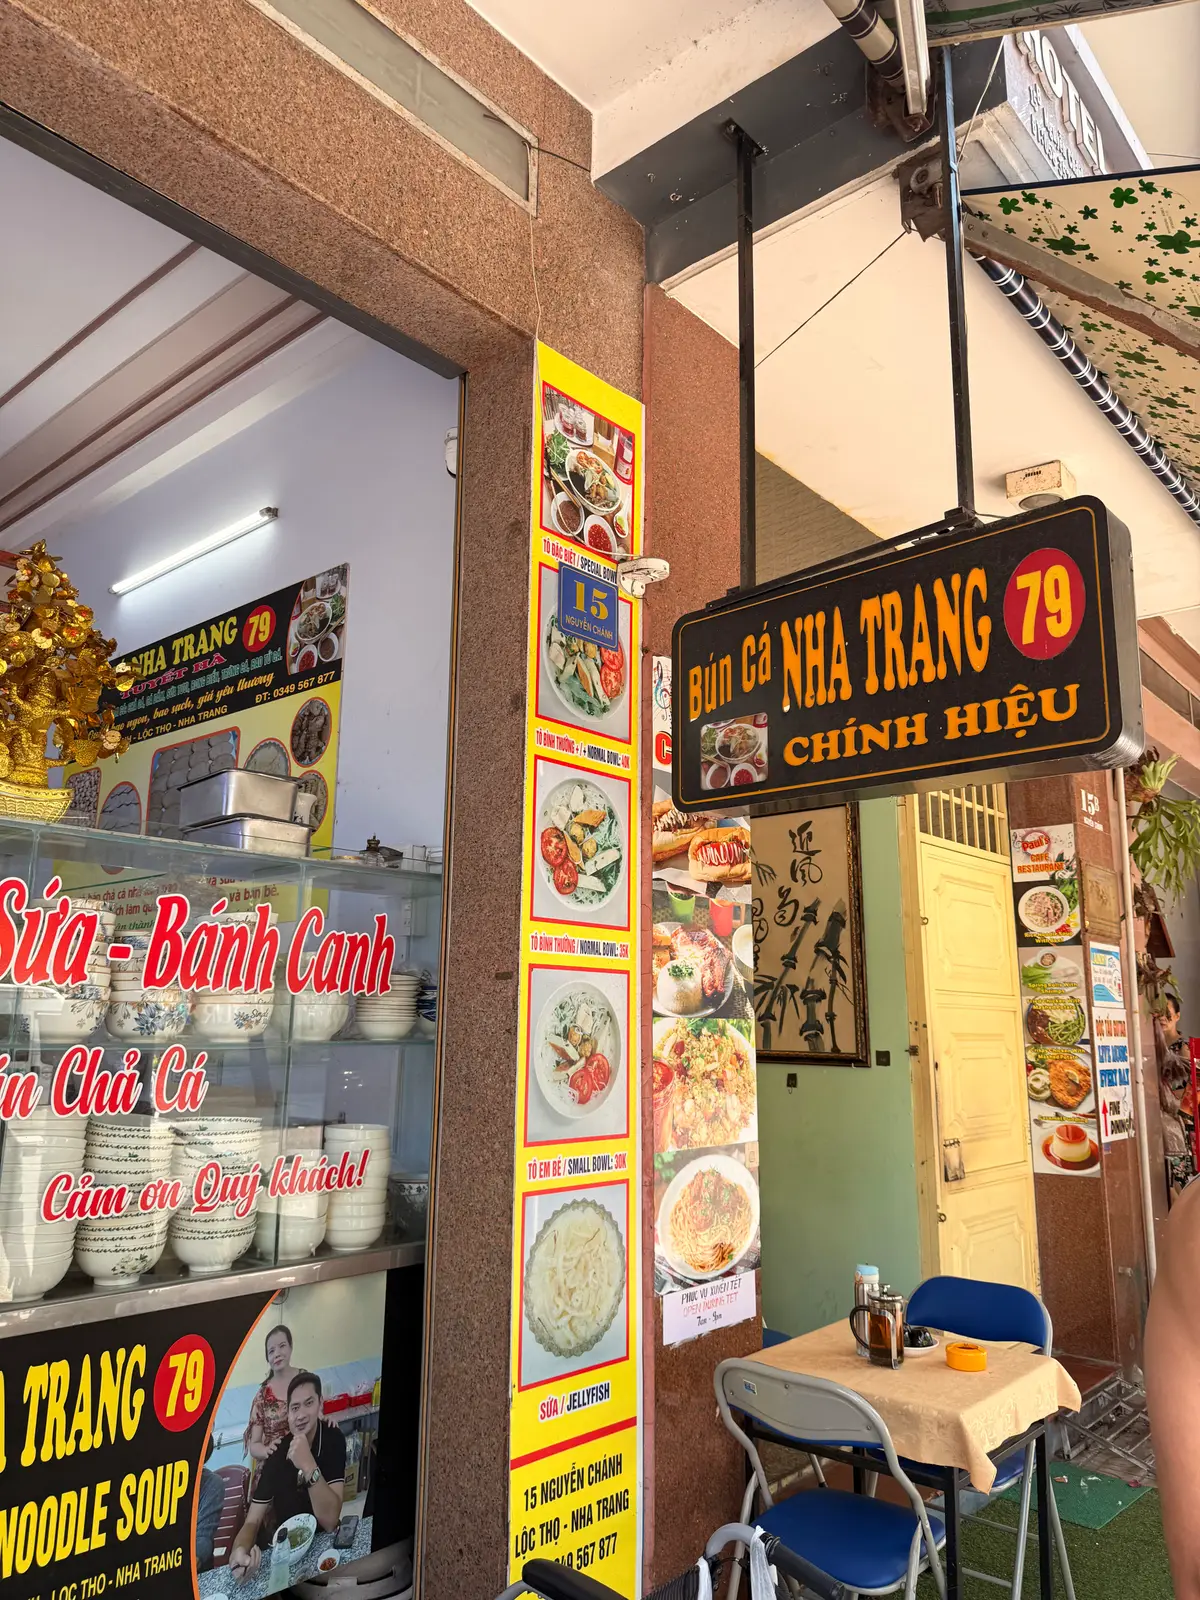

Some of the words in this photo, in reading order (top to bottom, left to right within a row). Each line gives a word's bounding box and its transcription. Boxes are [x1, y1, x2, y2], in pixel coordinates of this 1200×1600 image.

[580, 556, 602, 577] SPECIAL
[573, 580, 609, 620] 15
[172, 616, 238, 666] TRANG
[248, 611, 270, 646] 79
[565, 614, 591, 632] NGUYỄN
[592, 624, 613, 640] CHÁNH
[689, 652, 732, 722] Bún
[742, 621, 772, 693] Cá
[780, 607, 853, 712] NHA
[859, 567, 992, 695] TRANG
[1016, 564, 1072, 645] 79
[153, 708, 169, 719] bao
[196, 690, 214, 709] giá
[215, 685, 234, 703] yêu
[255, 692, 271, 703] ĐT:
[273, 684, 295, 699] 0349
[297, 678, 315, 691] 567
[317, 671, 335, 685] 877
[156, 723, 172, 734] THỌ
[178, 715, 195, 727] NHA
[198, 705, 228, 721] TRANG
[783, 712, 928, 767] CHÍNH
[944, 684, 1080, 739] HIỆU
[1022, 835, 1050, 852] Paul's
[1031, 853, 1049, 862] CAFE
[1017, 861, 1065, 873] RESTAURANT
[143, 894, 280, 992] Bánh
[286, 906, 397, 996] Canh
[580, 940, 601, 956] NORMAL
[51, 1045, 143, 1117] Chả
[154, 1044, 209, 1114] Cá
[1109, 1101, 1120, 1116] FINE
[528, 1159, 537, 1180] TÔ
[539, 1162, 551, 1178] EM
[552, 1156, 562, 1176] BÉ
[568, 1157, 591, 1175] SMALL
[592, 1155, 613, 1172] BOWL:
[615, 1153, 627, 1169] 30K
[42, 1171, 129, 1224] Cảm
[139, 1177, 186, 1212] ơn
[191, 1161, 266, 1219] Quý
[269, 1149, 370, 1199] khách!
[20, 1343, 147, 1467] TRANG
[166, 1349, 204, 1417] 79
[540, 1396, 559, 1421] SỨA
[566, 1382, 610, 1412] JELLYFISH
[524, 1486, 537, 1511] 15
[540, 1462, 584, 1506] NGUYỄN
[587, 1453, 623, 1486] CHÁNH
[0, 1480, 112, 1580] NOODLE
[116, 1459, 190, 1541] SOUP
[515, 1526, 536, 1560] LỘC
[539, 1517, 560, 1546] THỌ
[571, 1503, 593, 1533] NHA
[596, 1488, 630, 1519] TRANG
[115, 1563, 141, 1588] NHA
[144, 1548, 183, 1578] TRANG
[576, 1541, 596, 1570] 567
[599, 1532, 618, 1560] 877
